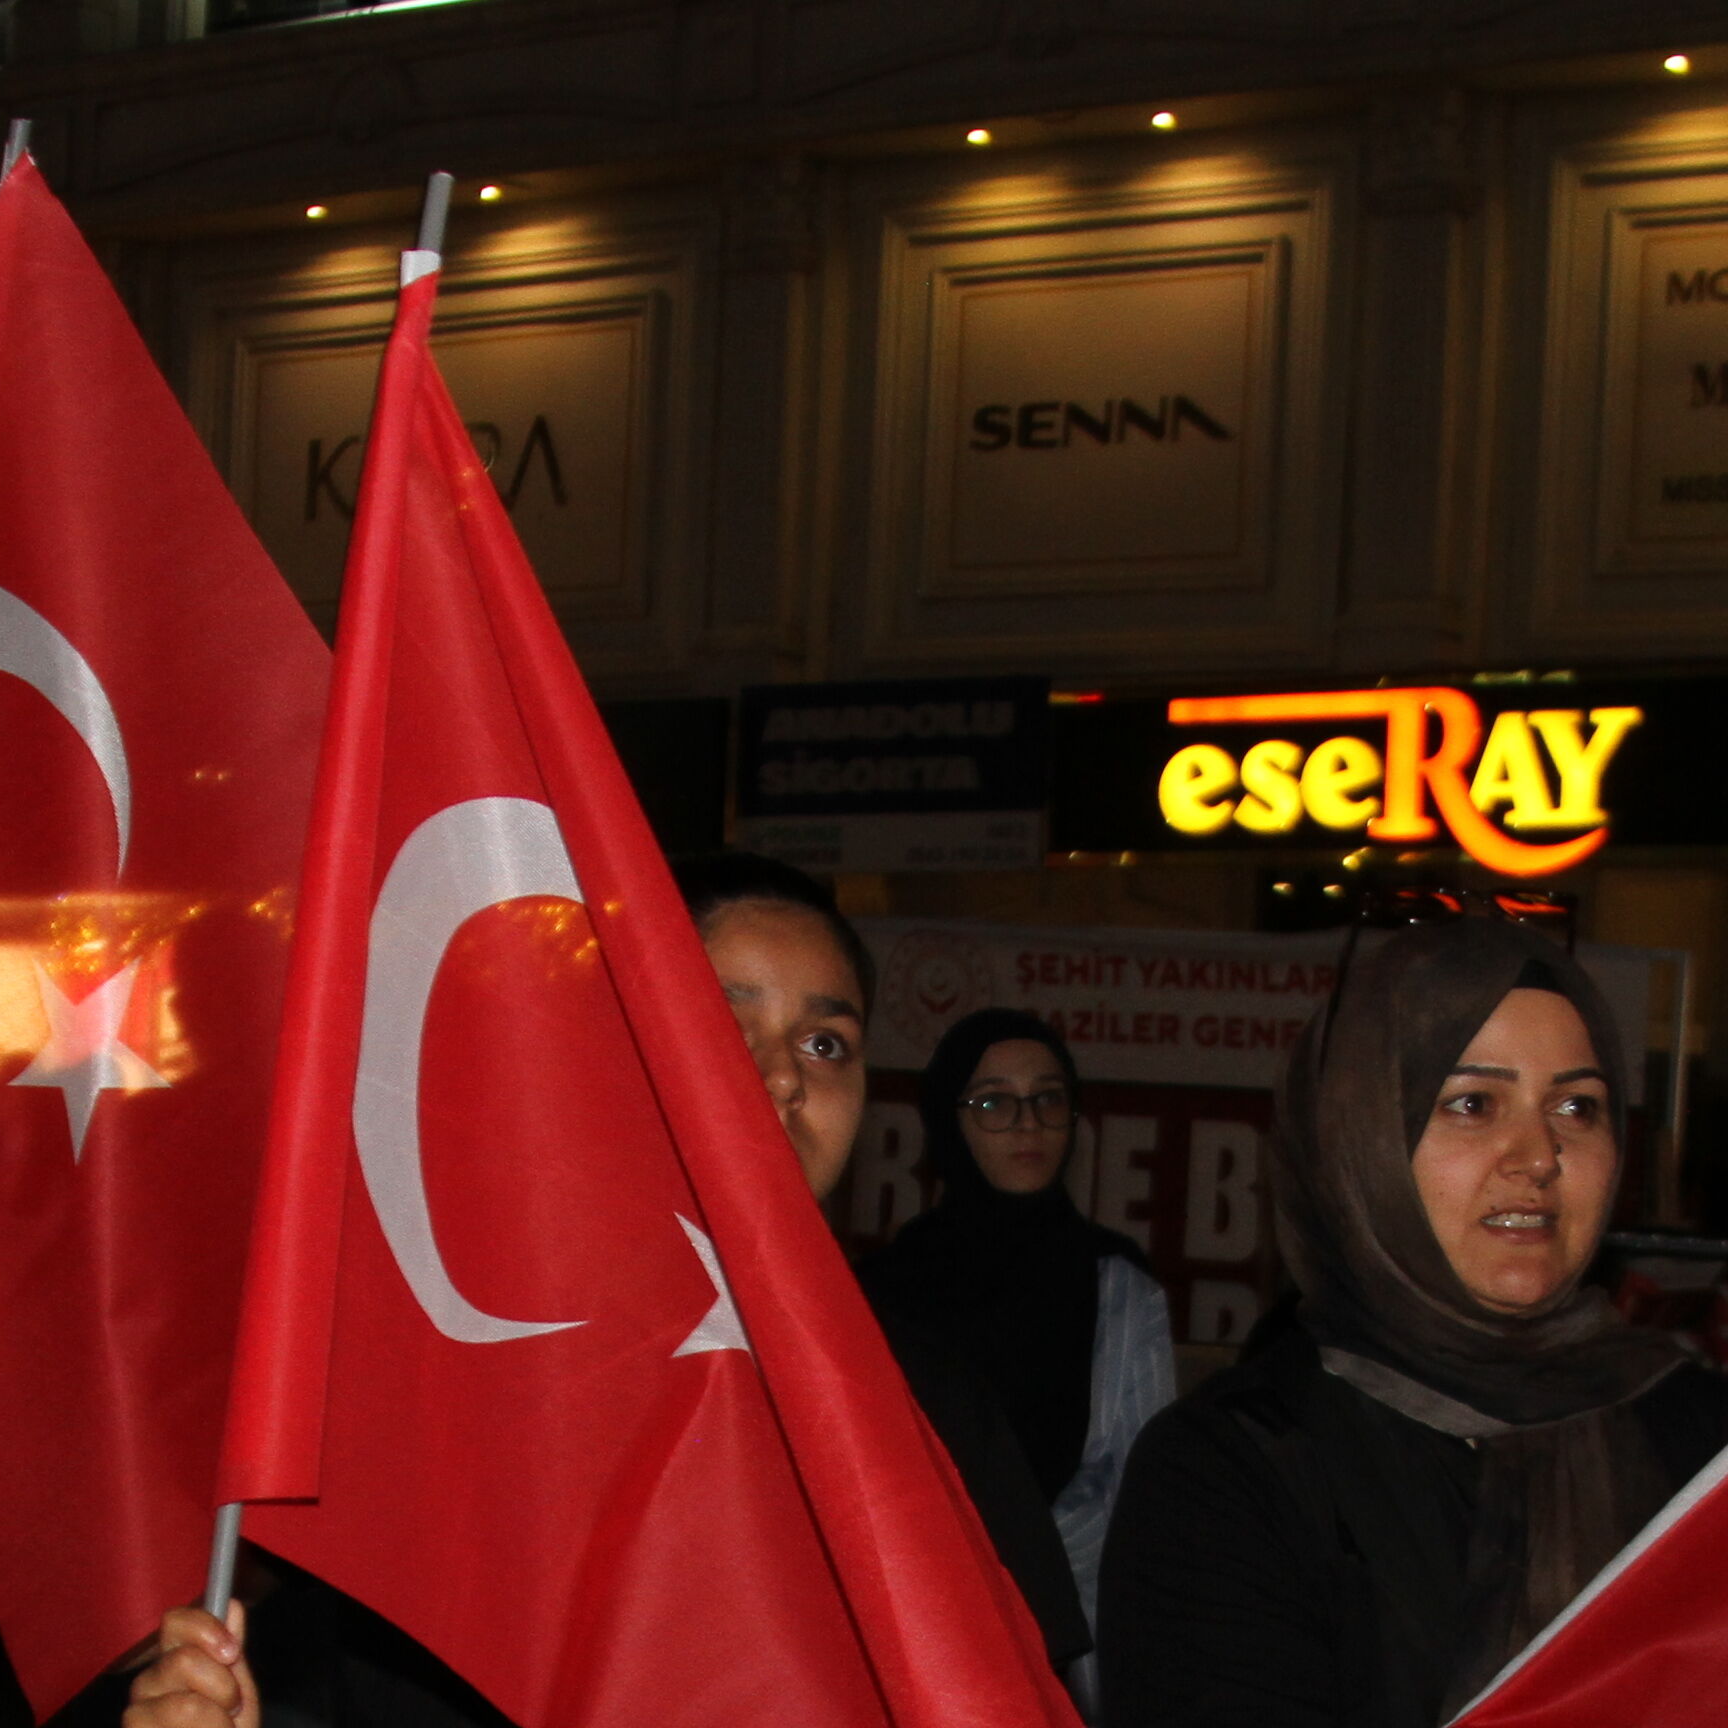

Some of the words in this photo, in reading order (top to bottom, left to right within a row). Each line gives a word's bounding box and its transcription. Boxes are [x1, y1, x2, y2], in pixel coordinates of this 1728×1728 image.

[969, 394, 1233, 451] SENNA
[1157, 687, 1646, 877] eseRAY
[1016, 950, 1128, 993] ŞEHİT
[1022, 1002, 1181, 1046] AZİLER
